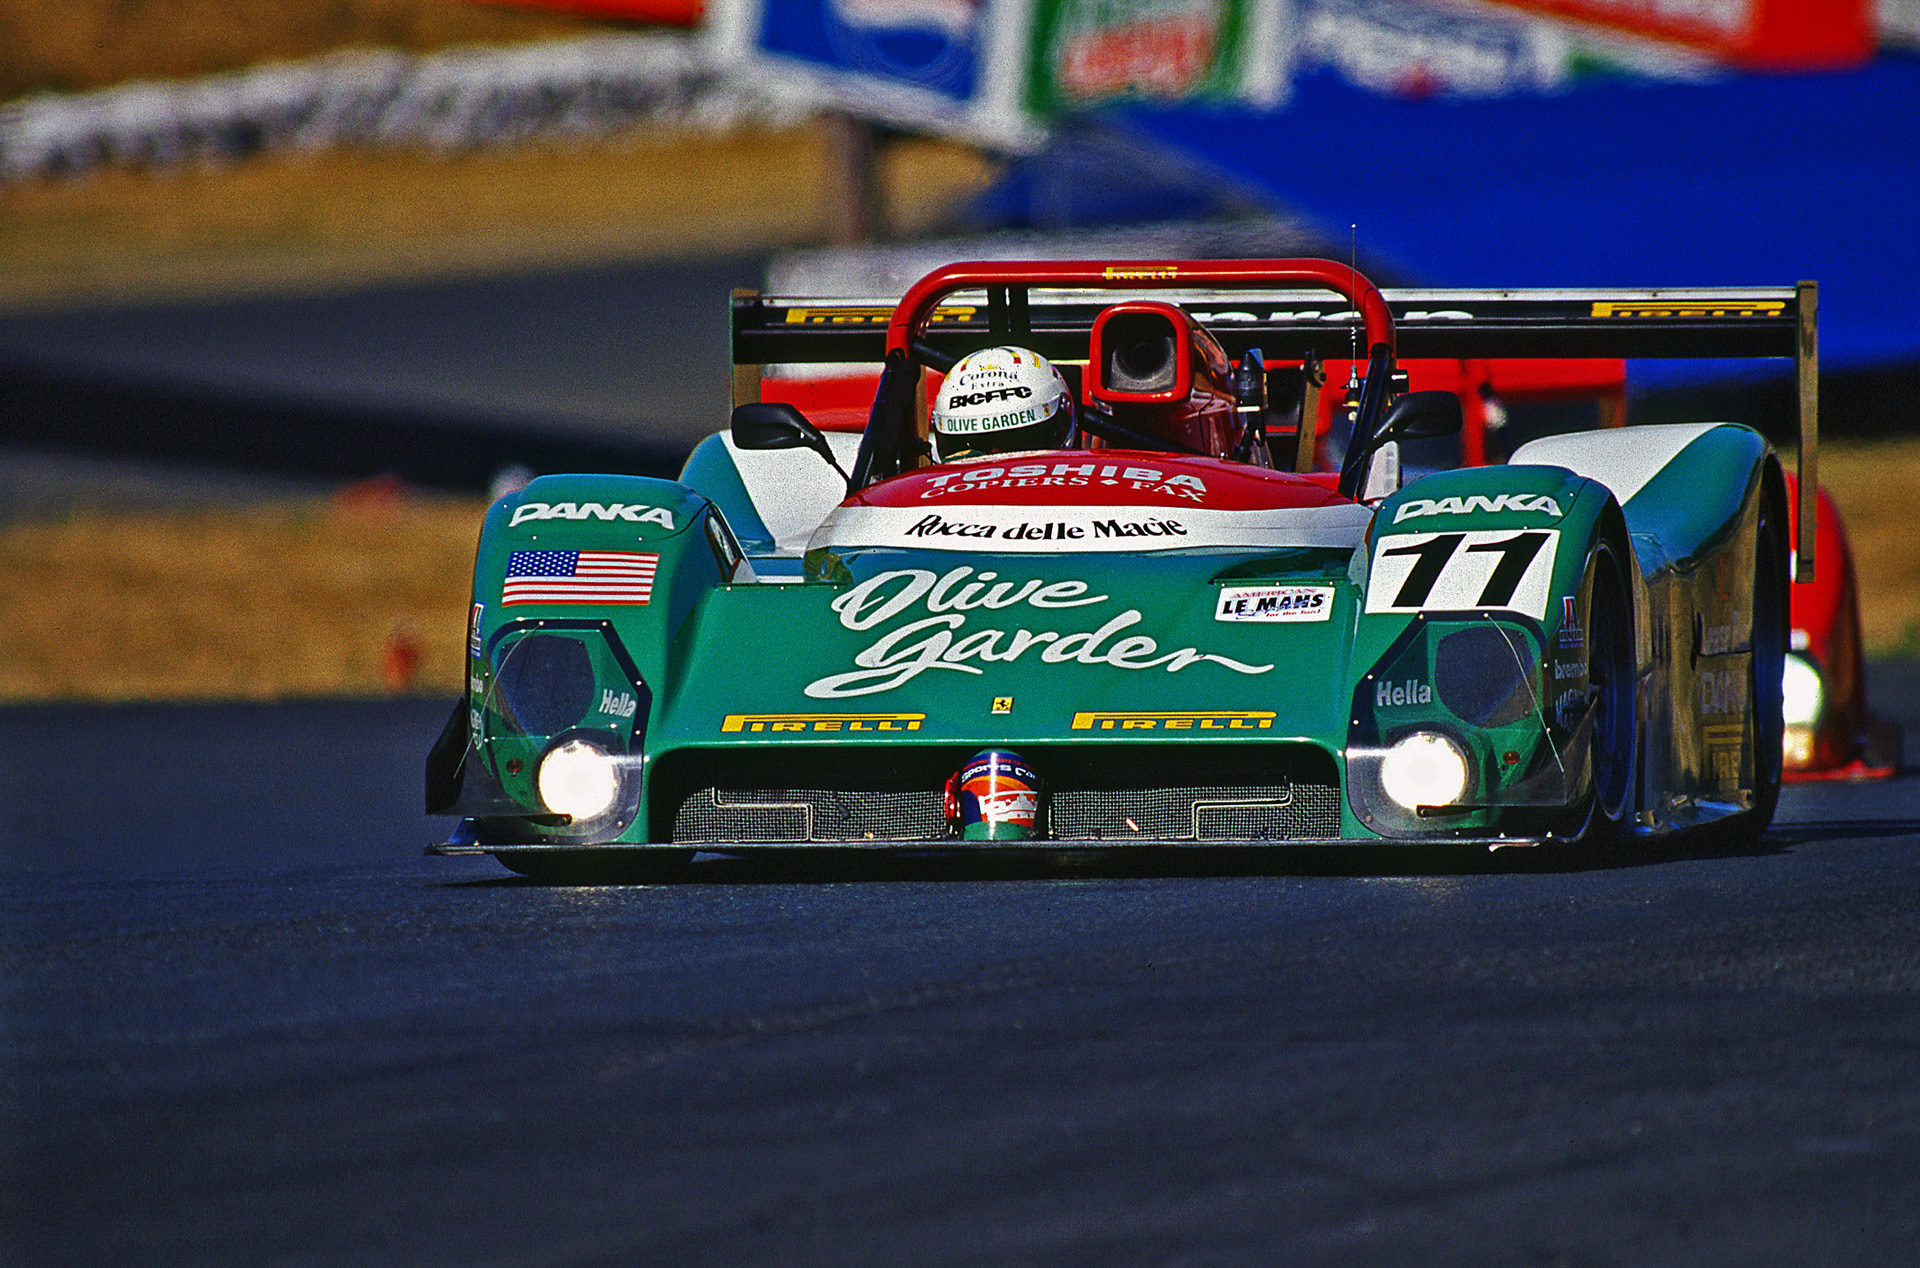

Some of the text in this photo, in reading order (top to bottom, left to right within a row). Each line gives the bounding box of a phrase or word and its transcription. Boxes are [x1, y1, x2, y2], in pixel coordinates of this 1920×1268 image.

[959, 369, 1018, 386] Corona
[971, 381, 1005, 390] Extra
[947, 409, 1037, 432] OLIVE GARDEN
[920, 477, 1204, 503] COPIERS FAX
[926, 464, 1208, 493] TOSHIBA
[509, 502, 675, 530] DANKA
[1393, 494, 1563, 525] DANKA
[904, 514, 997, 538] Rocca
[1002, 522, 1085, 541] delle
[1382, 532, 1552, 607] 11
[831, 566, 1109, 630] Olive
[1222, 599, 1249, 615] LE
[1256, 594, 1324, 612] MANS
[803, 610, 1275, 699] Garden
[599, 688, 637, 718] Hella
[1376, 679, 1432, 706] Hella
[721, 713, 927, 732] PIRELLI
[1071, 711, 1278, 730] PIRELLI
